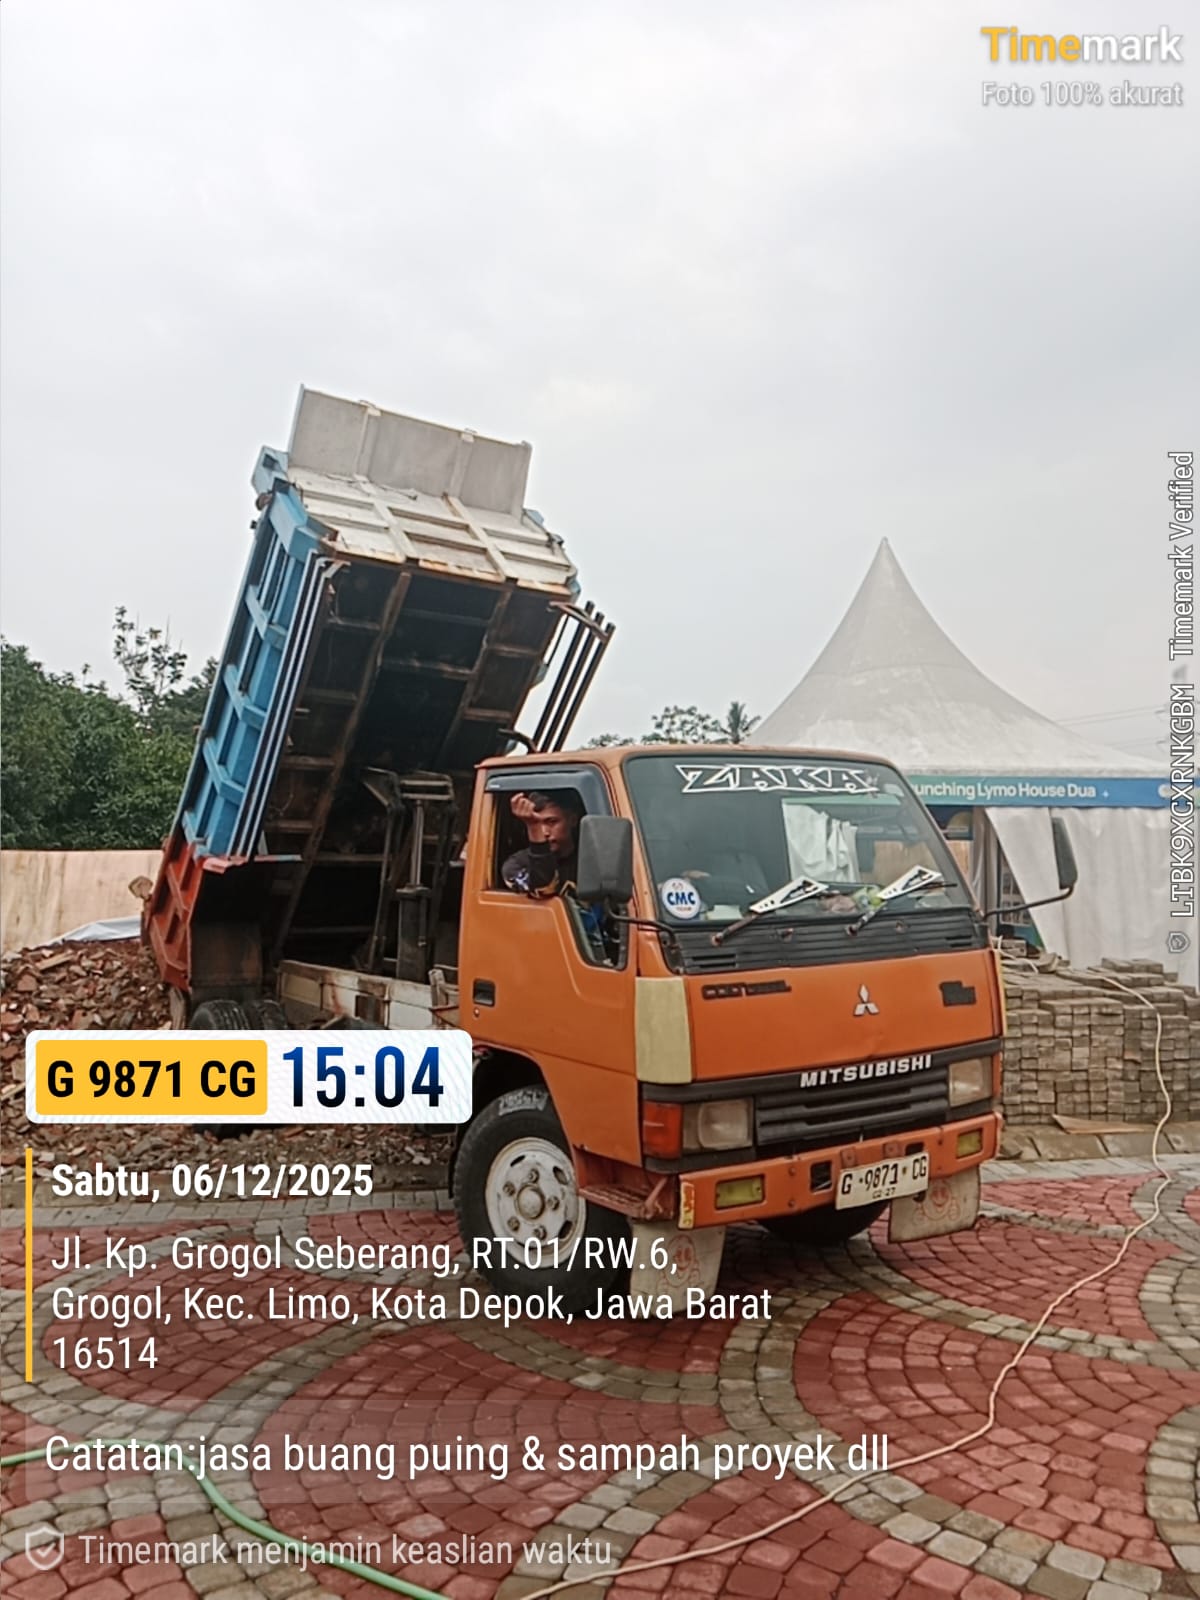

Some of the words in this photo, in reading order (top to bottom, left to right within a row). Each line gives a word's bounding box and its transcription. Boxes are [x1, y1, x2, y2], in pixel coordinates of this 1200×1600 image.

[977, 783, 1017, 801] Lymo
[1019, 783, 1066, 797] House
[1068, 783, 1096, 797] Dua
[667, 891, 696, 905] CMC
[800, 1054, 932, 1088] MITSUBISHI
[841, 1174, 853, 1195] G
[864, 1163, 898, 1191] 9871
[912, 1156, 927, 1179] CG
